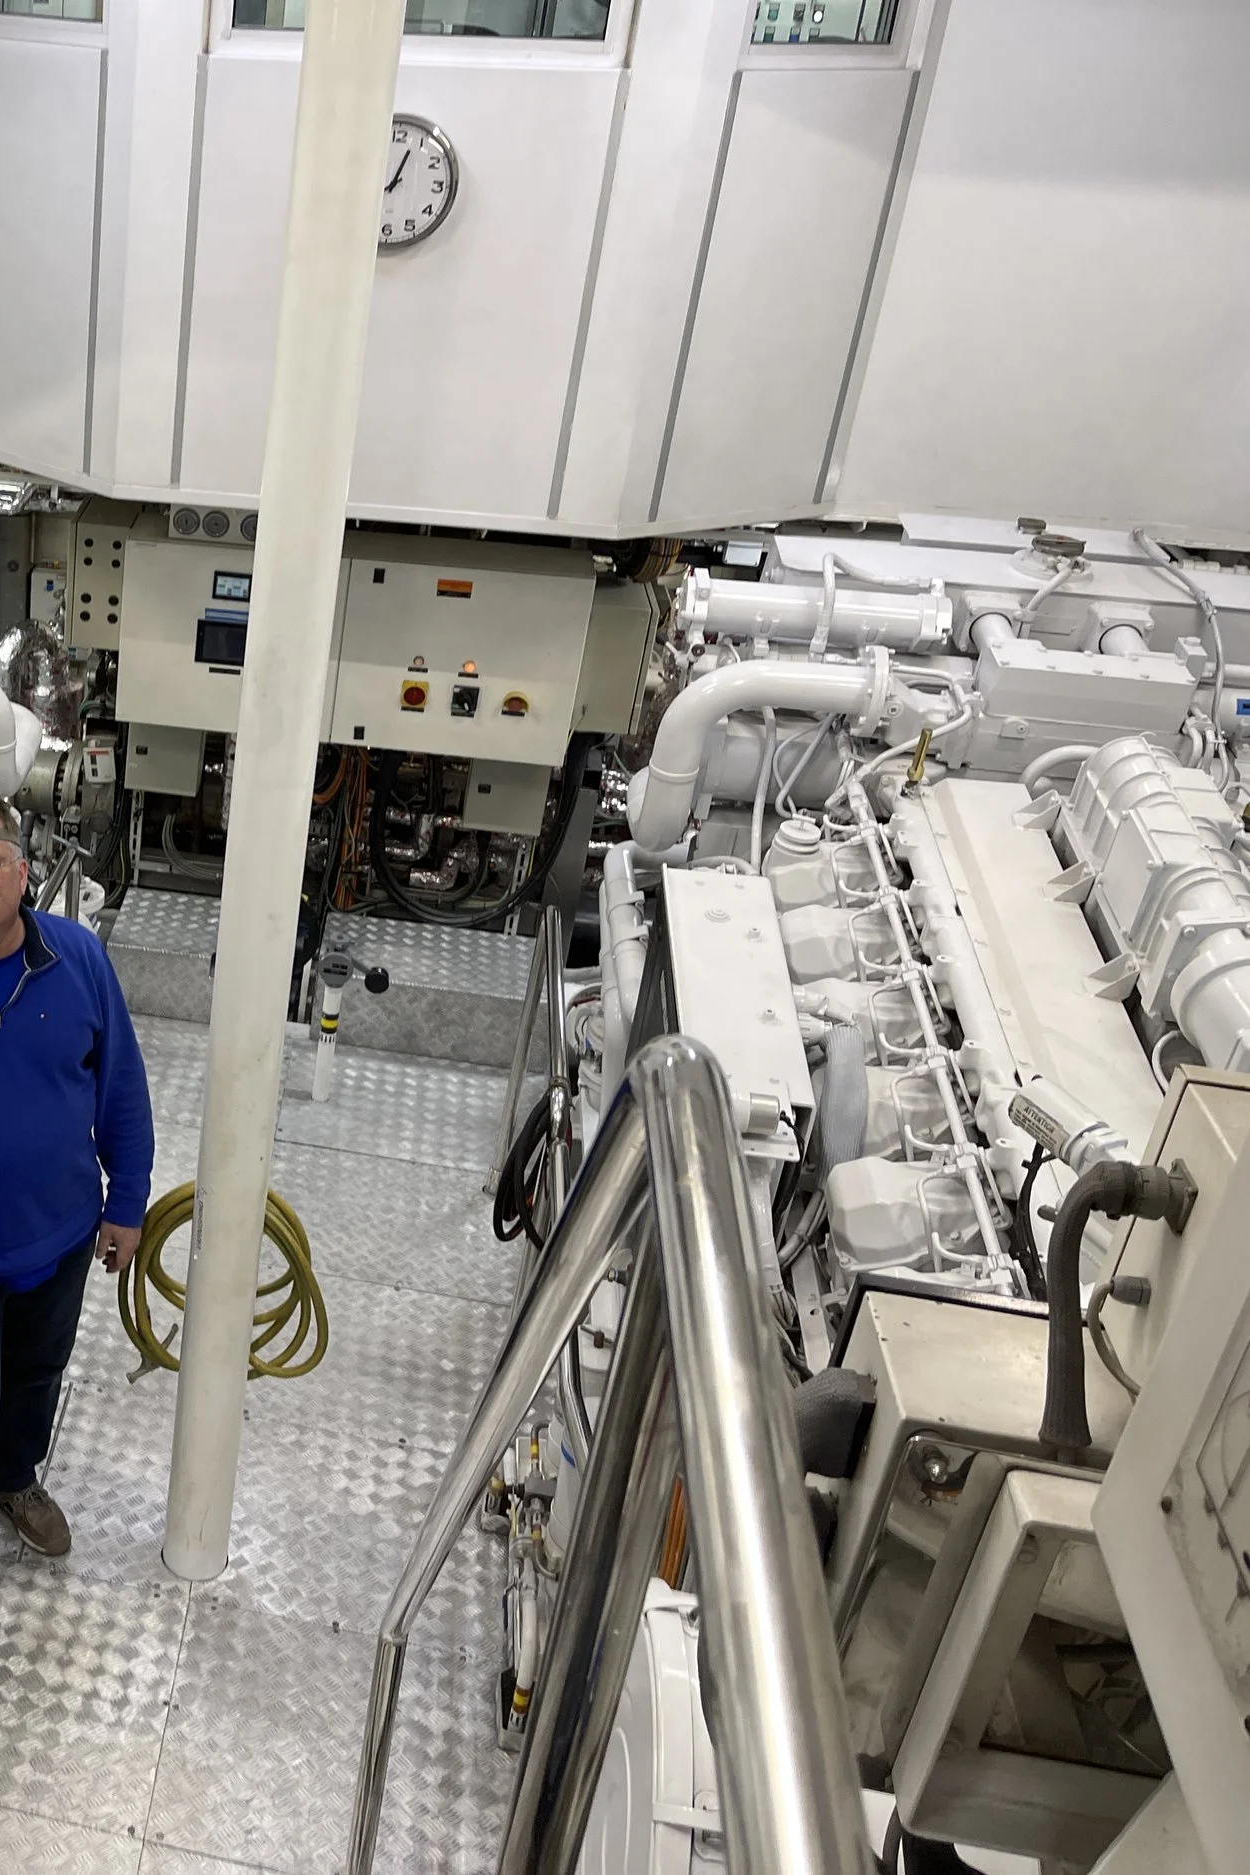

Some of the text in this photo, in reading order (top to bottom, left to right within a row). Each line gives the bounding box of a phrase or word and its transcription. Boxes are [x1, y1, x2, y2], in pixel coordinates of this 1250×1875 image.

[392, 129, 408, 143] 12
[428, 156, 440, 169] 2
[431, 180, 444, 193] 3
[421, 204, 433, 216] 4
[381, 223, 392, 236] 6
[404, 219, 415, 231] 5
[1023, 1106, 1055, 1133] ATTENTION
